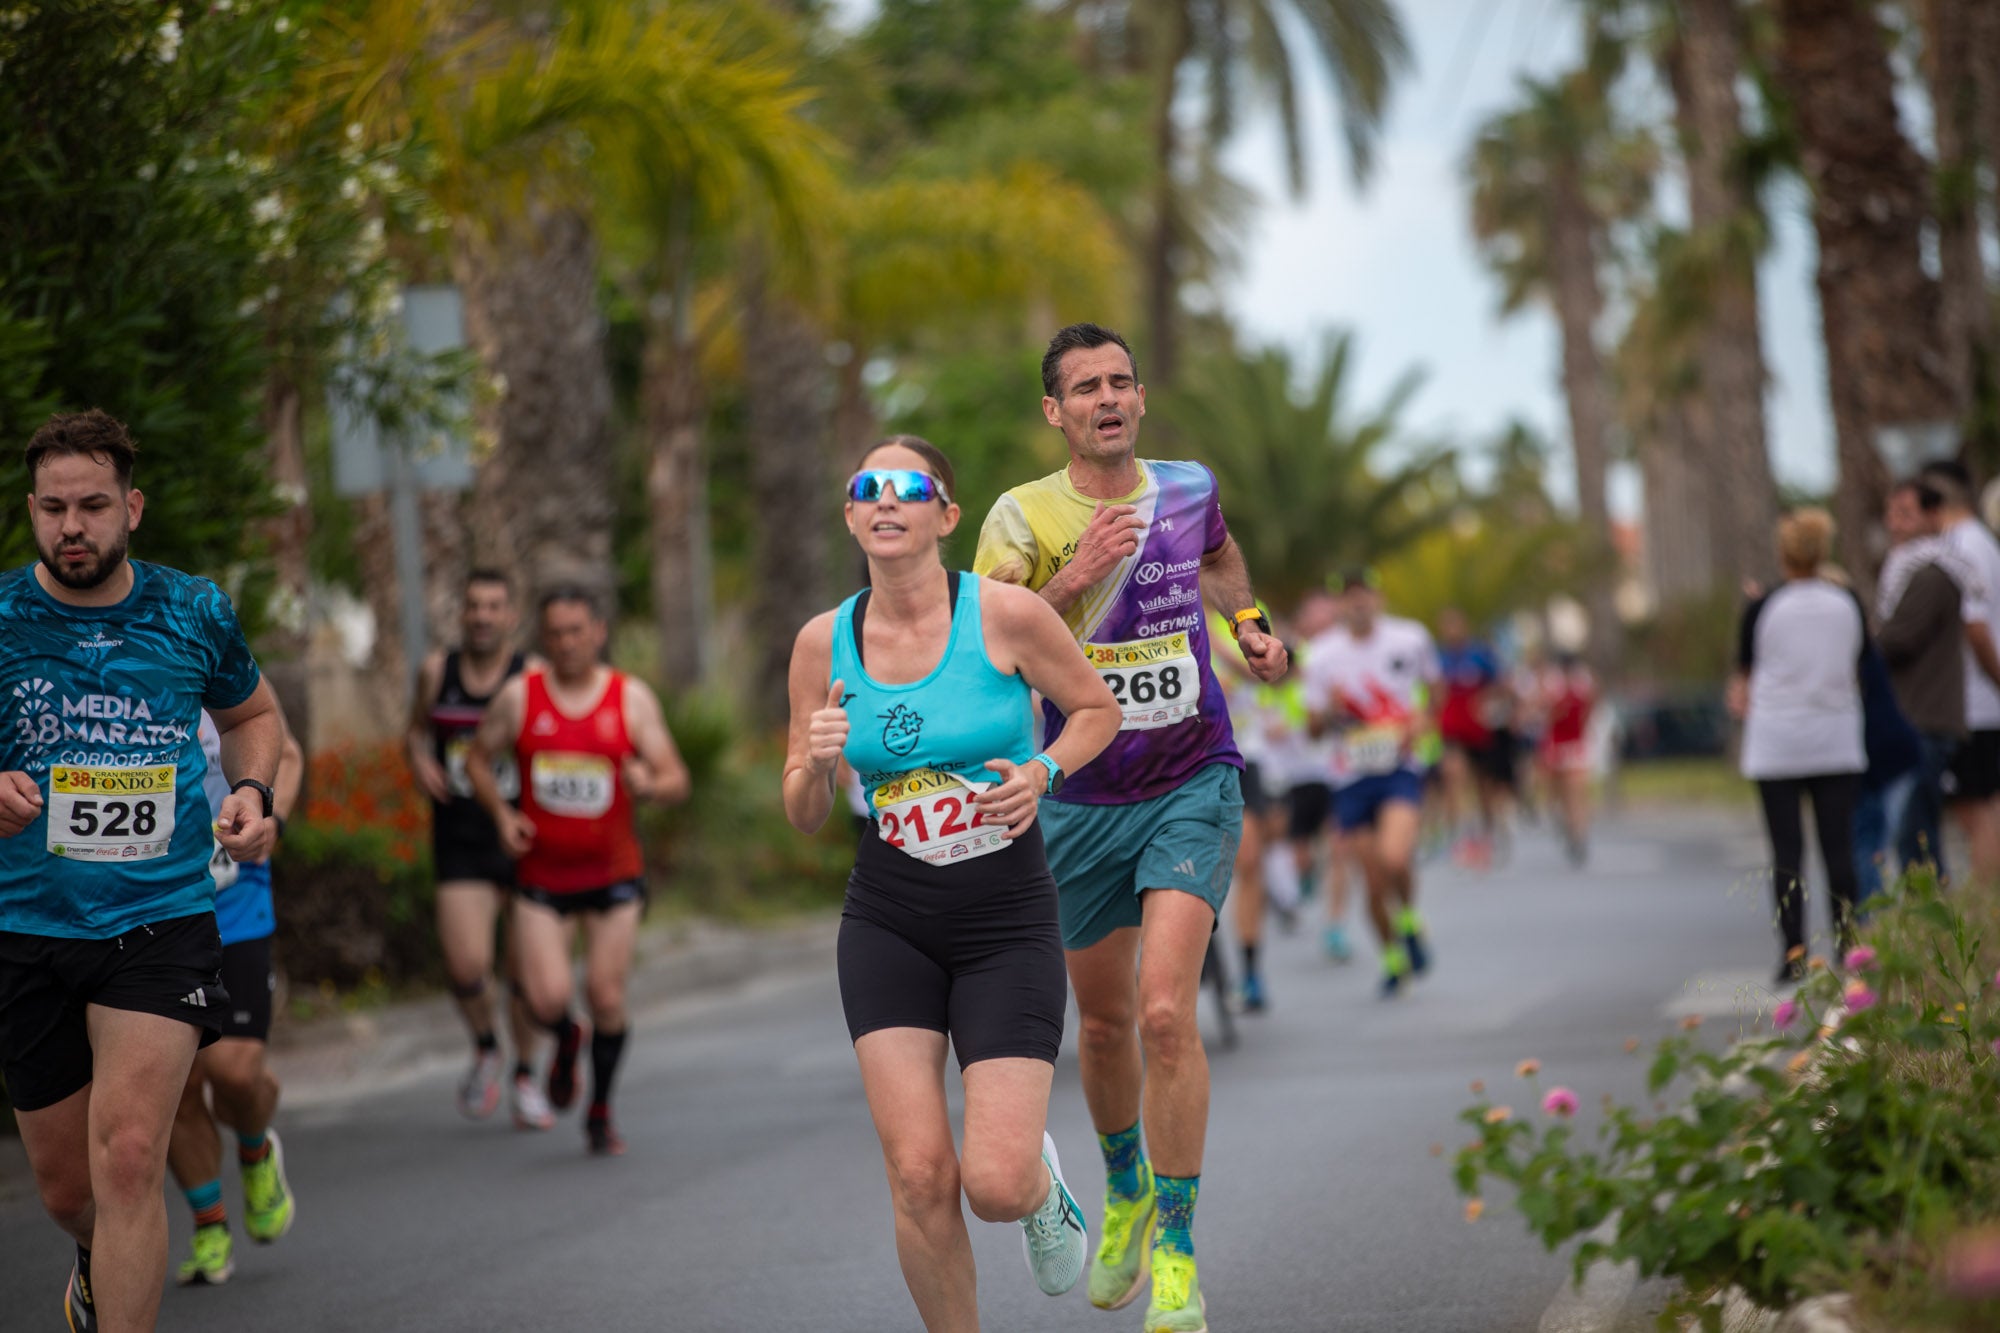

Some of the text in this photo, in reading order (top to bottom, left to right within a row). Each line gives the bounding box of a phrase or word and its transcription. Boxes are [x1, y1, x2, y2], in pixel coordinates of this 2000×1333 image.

[1138, 612, 1199, 637] OKEYMAS
[1096, 646, 1169, 663] 38 FONDO
[1103, 666, 1182, 706] 268
[62, 694, 152, 721] MEDIA
[16, 713, 61, 744] 38
[63, 718, 191, 746] MARATÓN
[70, 771, 91, 788] 38
[91, 777, 154, 790] FONDO
[69, 800, 156, 836] 528
